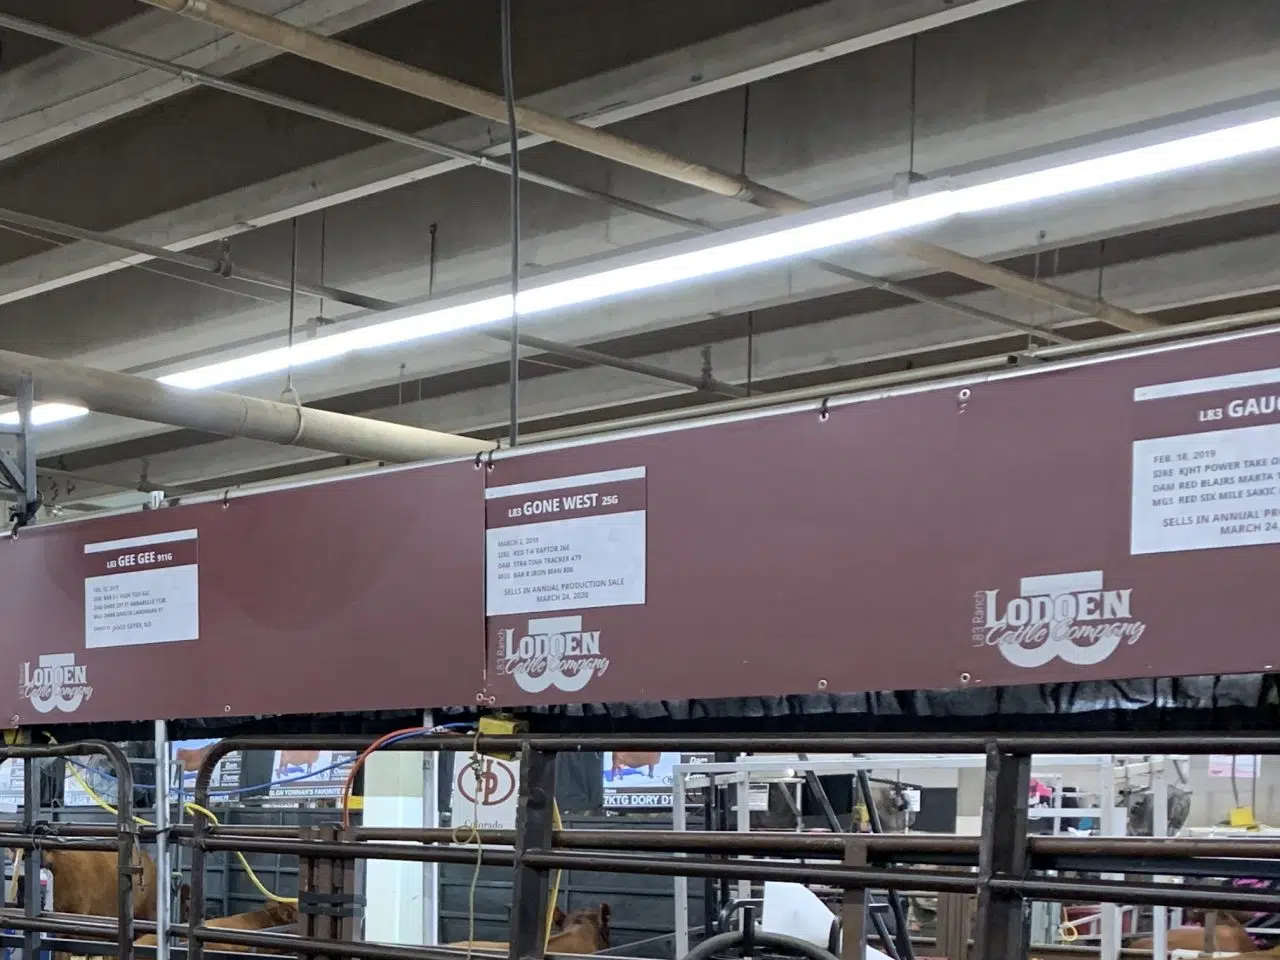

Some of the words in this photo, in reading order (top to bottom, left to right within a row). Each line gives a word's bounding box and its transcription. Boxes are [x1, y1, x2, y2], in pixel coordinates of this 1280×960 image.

[1204, 461, 1240, 472] POWER
[1243, 458, 1267, 468] TAKE
[1179, 481, 1197, 490] RED
[1200, 476, 1235, 488] BLAIRS
[523, 498, 560, 515] GONE
[562, 493, 599, 510] WEST
[1178, 495, 1197, 504] RED
[1200, 493, 1216, 502] SIX
[1163, 517, 1193, 527] SELLS
[1196, 515, 1209, 524] IN
[1212, 510, 1260, 523] ANNUAL
[1220, 523, 1261, 535] MARCH
[118, 554, 136, 566] GEE
[137, 551, 155, 564] GEE
[544, 555, 569, 565] TRACKER
[504, 587, 522, 596] SELLS
[532, 583, 559, 593] ANNUAL
[561, 579, 606, 591] PRODUCTION
[607, 577, 624, 586] SALE
[985, 588, 1133, 628] LODOEN
[985, 621, 1048, 646] Cattle
[1051, 619, 1146, 645] Company
[505, 628, 601, 660] LODOEN
[631, 795, 659, 805] DORY
